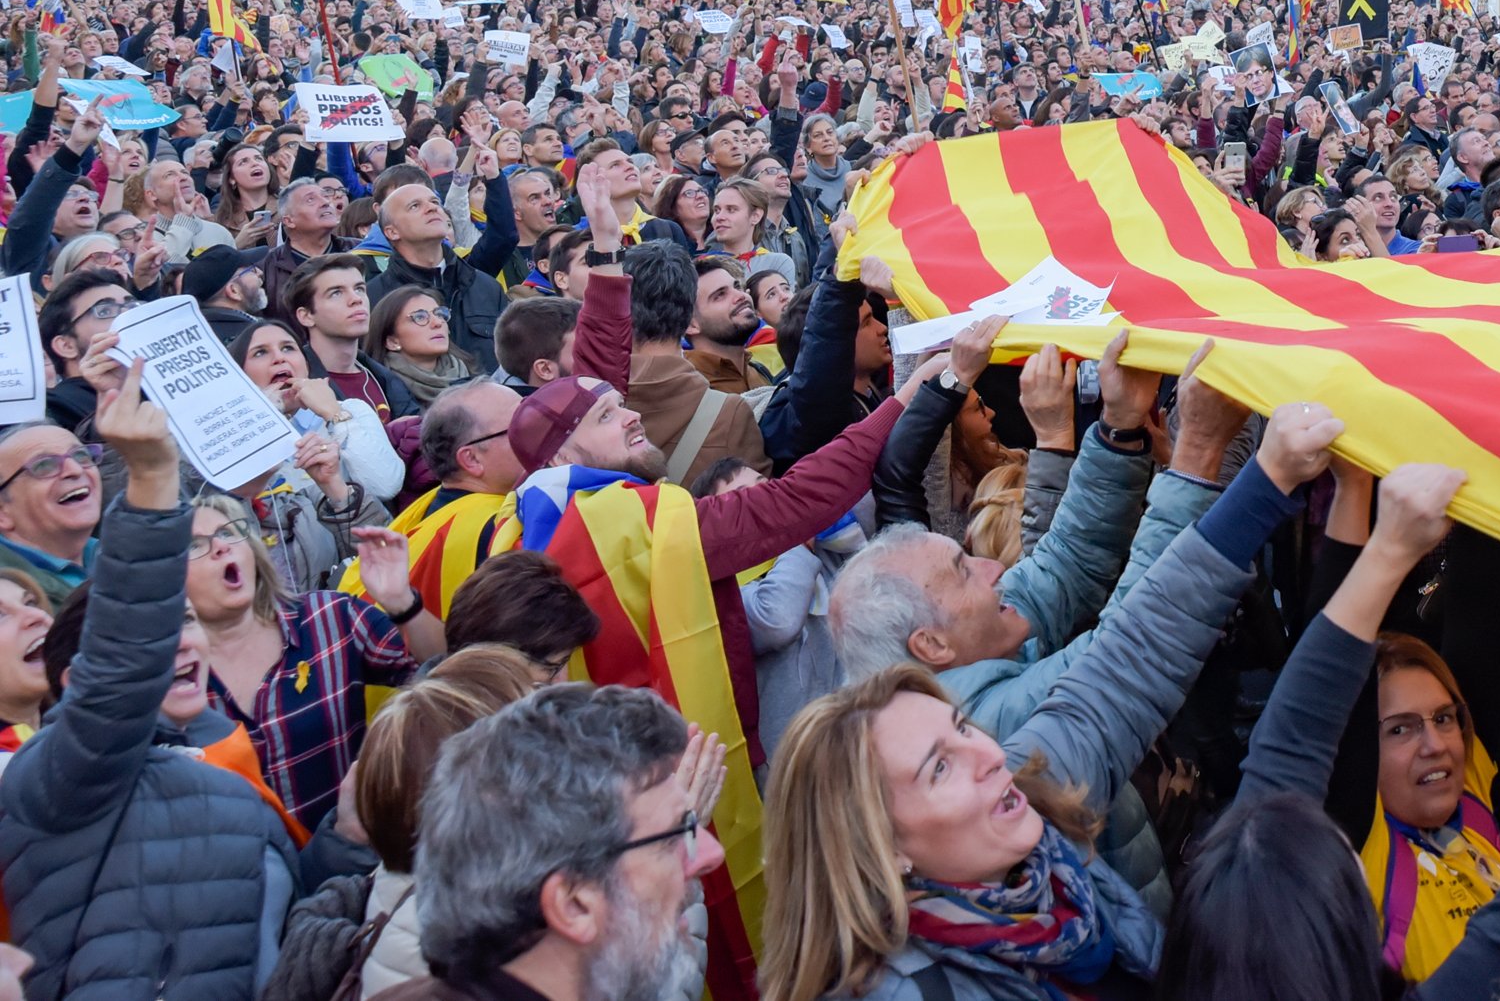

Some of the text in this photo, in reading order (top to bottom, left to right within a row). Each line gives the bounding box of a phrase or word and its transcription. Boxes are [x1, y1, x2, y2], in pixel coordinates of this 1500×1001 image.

[315, 93, 381, 104] LLIBERTAT
[318, 103, 381, 115] PRESOS
[132, 324, 203, 363] LLIBERTAT
[154, 345, 211, 379] PRESOS
[163, 361, 229, 400] POLÍTICS
